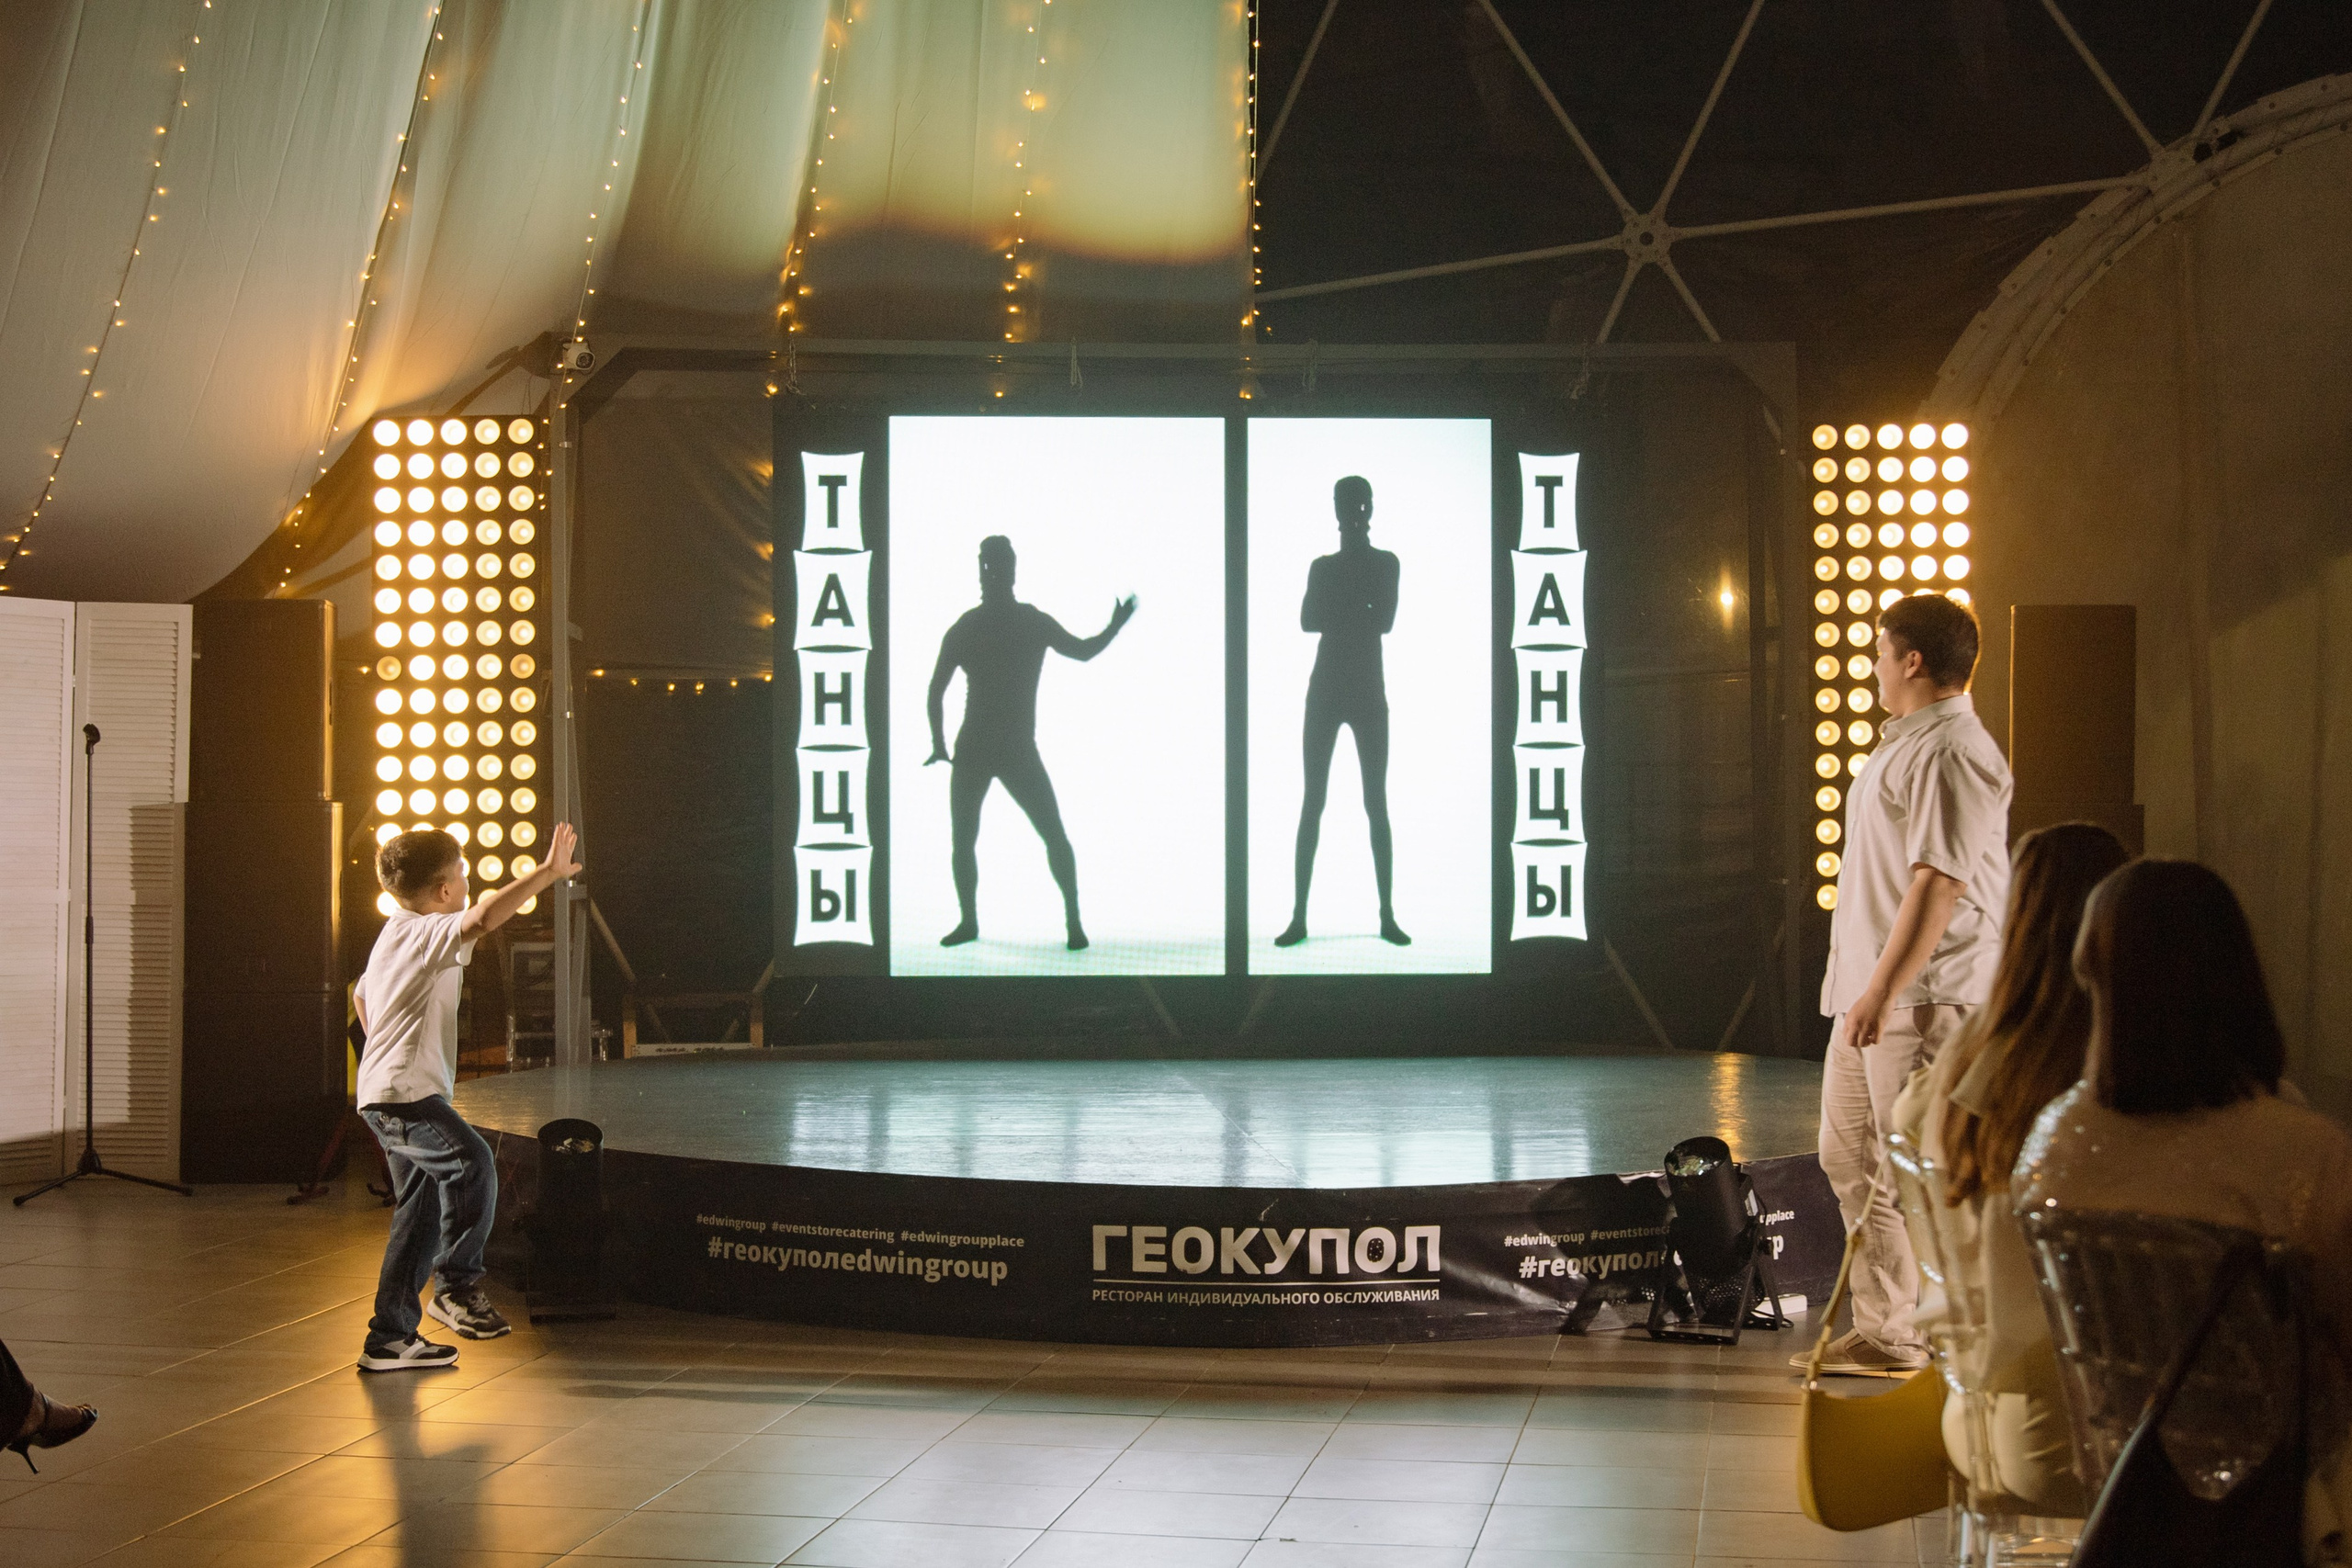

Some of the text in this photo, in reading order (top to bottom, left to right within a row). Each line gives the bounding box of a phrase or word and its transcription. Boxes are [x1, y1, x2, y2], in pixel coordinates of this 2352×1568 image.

[809, 474, 857, 924] ТАНЦЫ
[1525, 475, 1573, 919] ТАНЦЫ
[696, 1213, 1025, 1248] #edwingroup #eventstorecatering #edwingroupplace
[1092, 1224, 1441, 1275] ГЕОКУПОЛ
[1504, 1232, 1586, 1247] #edwingroup
[1092, 1289, 1441, 1306] РЕСТОРАН ИНДИВИДУАЛЬНОГО ОБСЛУЖИВАНИЯ
